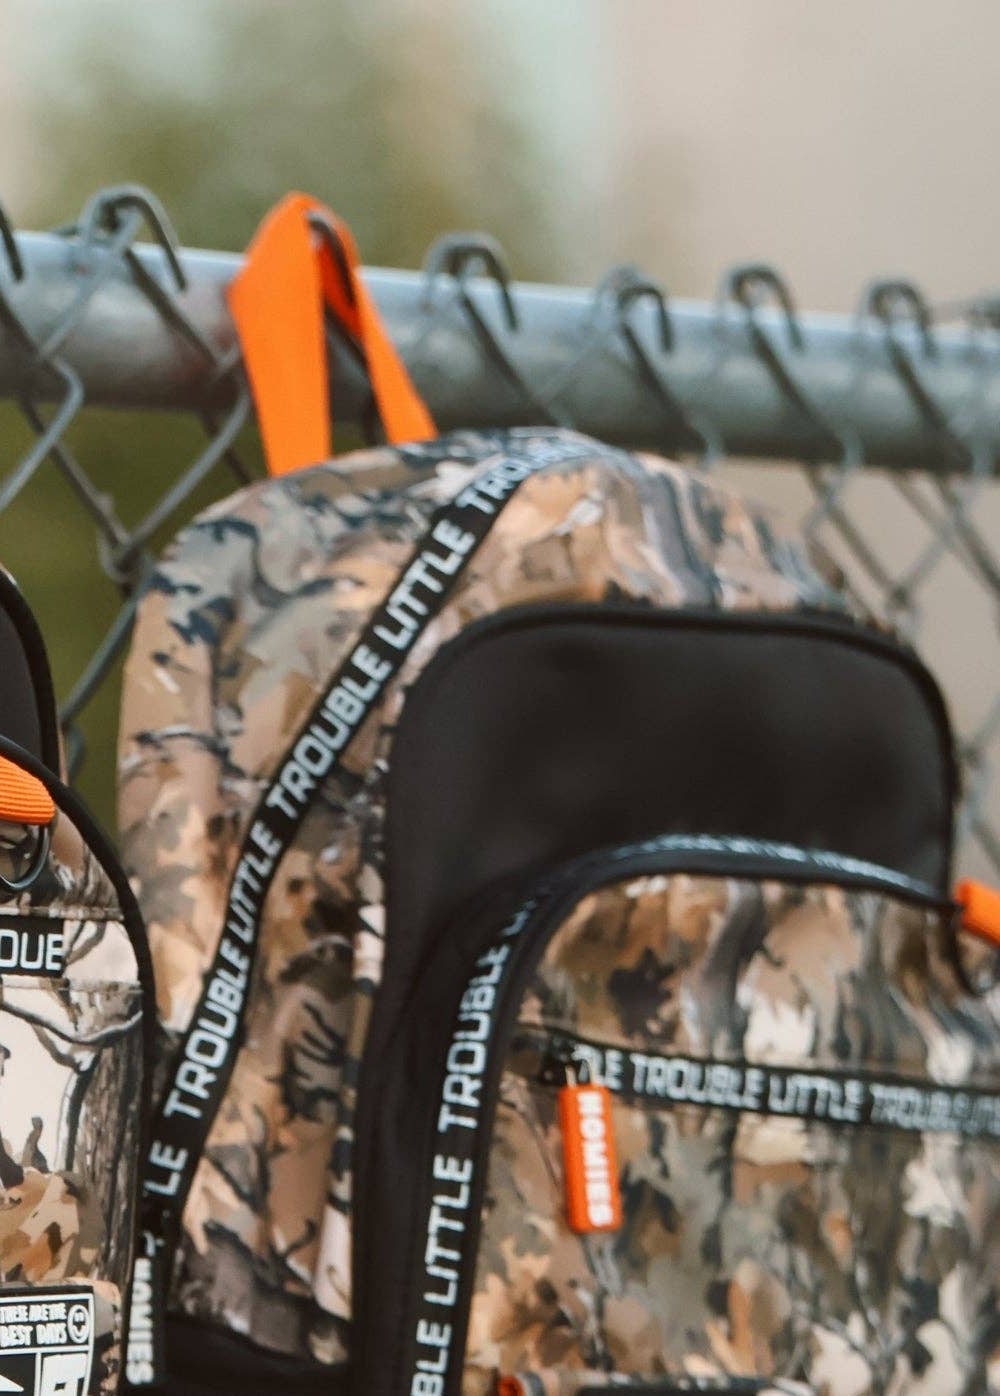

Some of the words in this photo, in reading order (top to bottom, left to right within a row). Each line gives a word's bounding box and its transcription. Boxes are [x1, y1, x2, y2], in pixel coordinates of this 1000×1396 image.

[163, 938, 252, 1120] TROUBLE
[227, 820, 282, 944] LITTLE
[266, 645, 393, 819] TROUBLE
[372, 519, 476, 650] LITTLE
[577, 1091, 614, 1228] HOMIES
[630, 1053, 765, 1110] TROUBLE
[768, 1073, 862, 1123] LITTLE
[424, 1154, 472, 1307] LITTLE
